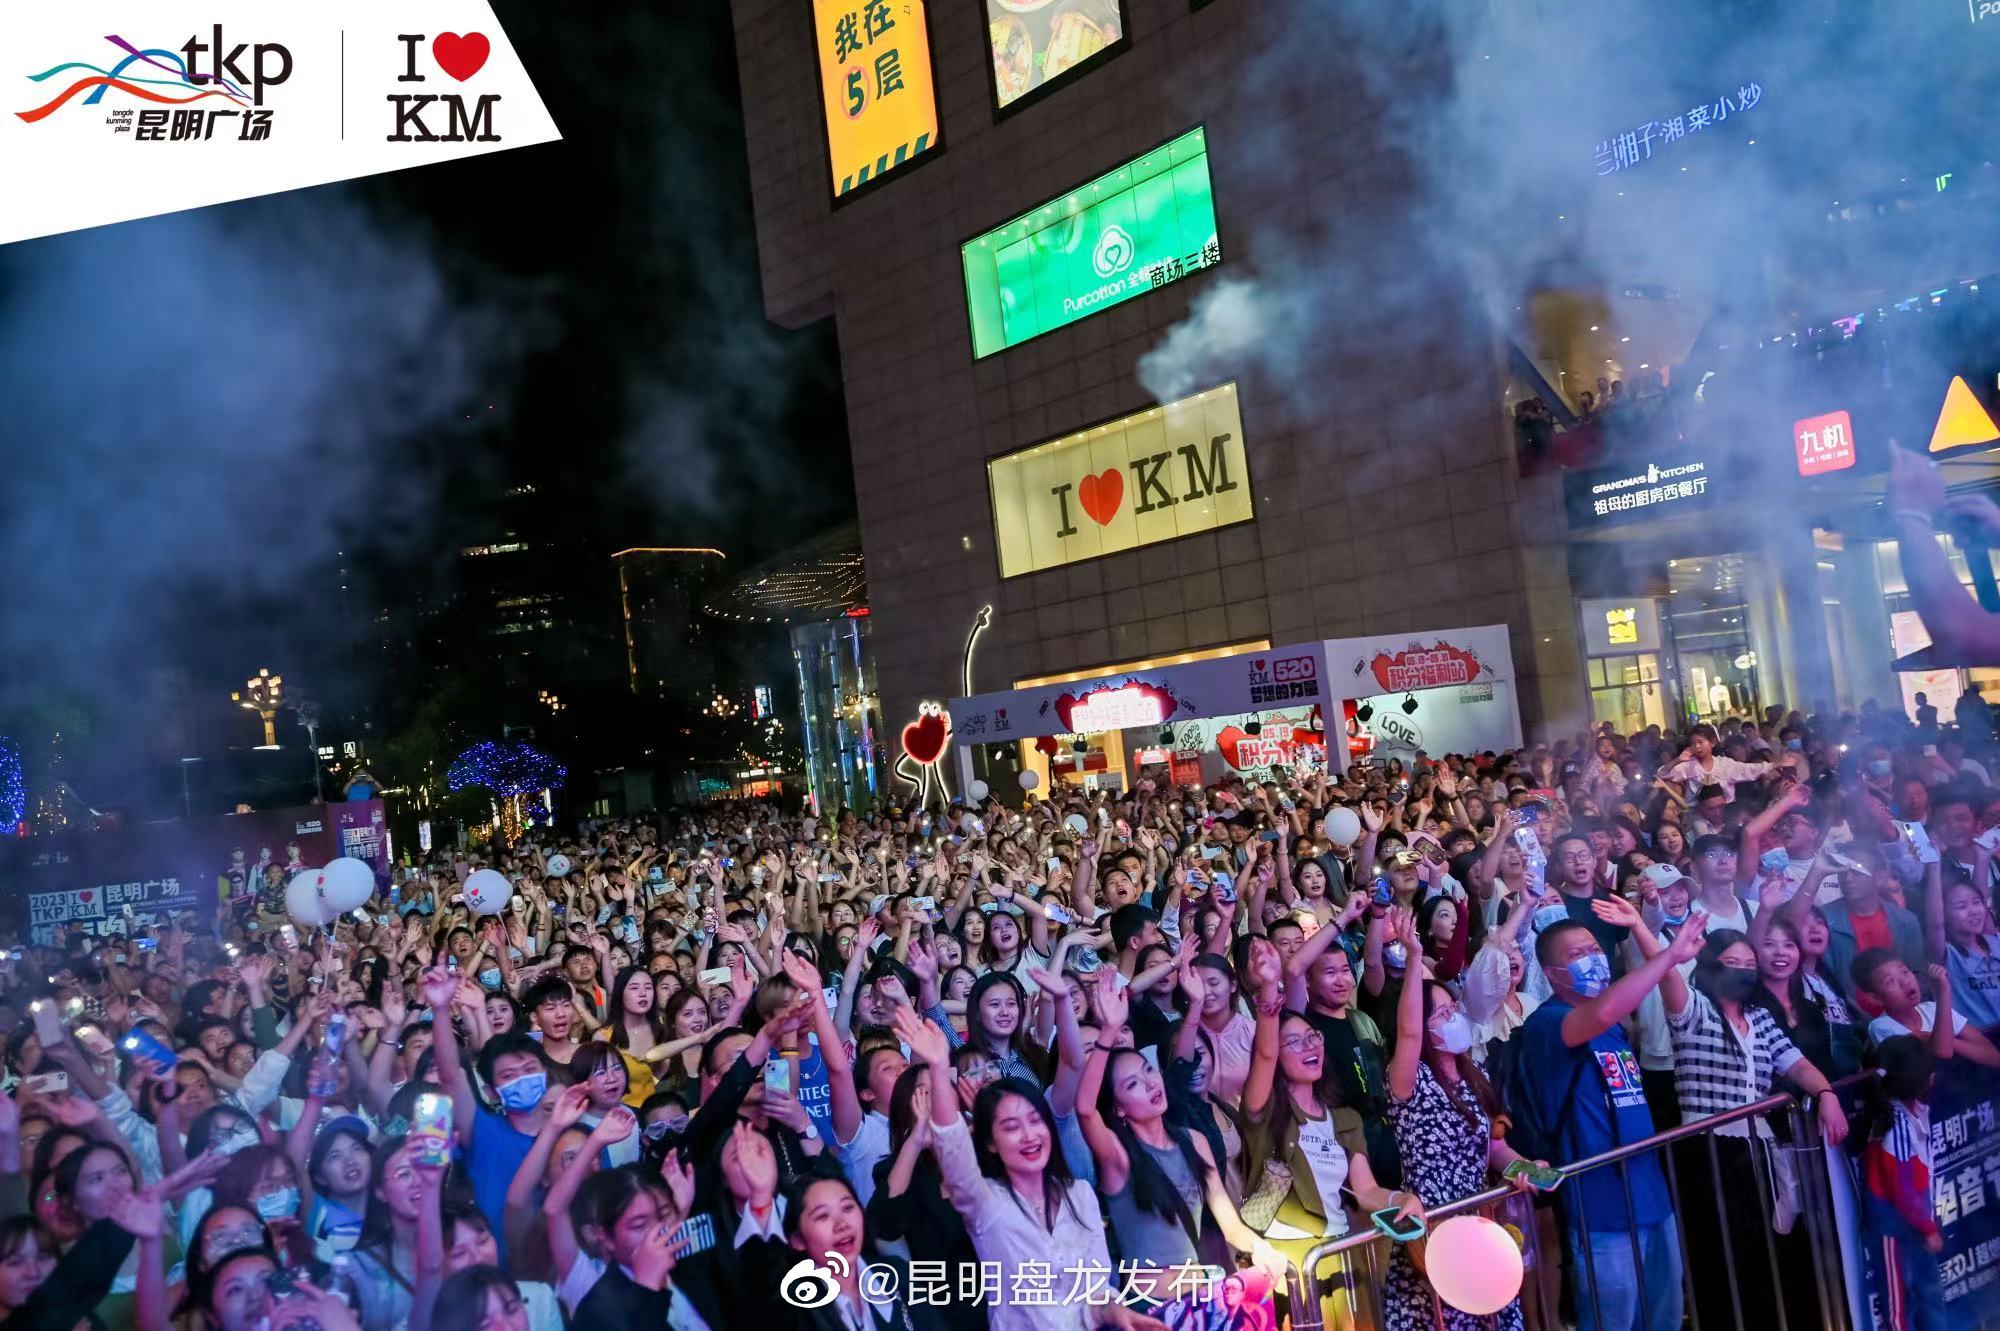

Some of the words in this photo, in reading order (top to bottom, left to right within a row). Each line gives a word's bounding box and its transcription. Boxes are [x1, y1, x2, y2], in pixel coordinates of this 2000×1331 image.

[835, 0, 895, 64] 我在
[848, 49, 904, 116] 5层
[1799, 423, 1848, 456] 九机
[1051, 484, 1078, 538] I
[1129, 433, 1238, 516] KM
[1592, 475, 1647, 494] GRANDMA'S
[1660, 462, 1705, 479] KITCHEN
[1593, 476, 1708, 516] 祖母的厨房西餐厅
[1248, 671, 1269, 686] KM
[1275, 657, 1315, 681] 520
[1389, 661, 1468, 690] 积分福利站
[1381, 715, 1416, 747] LOVE
[32, 894, 66, 909] 2023
[105, 878, 181, 904] 昆明广场
[33, 906, 65, 921] TKP
[71, 903, 98, 918] KM
